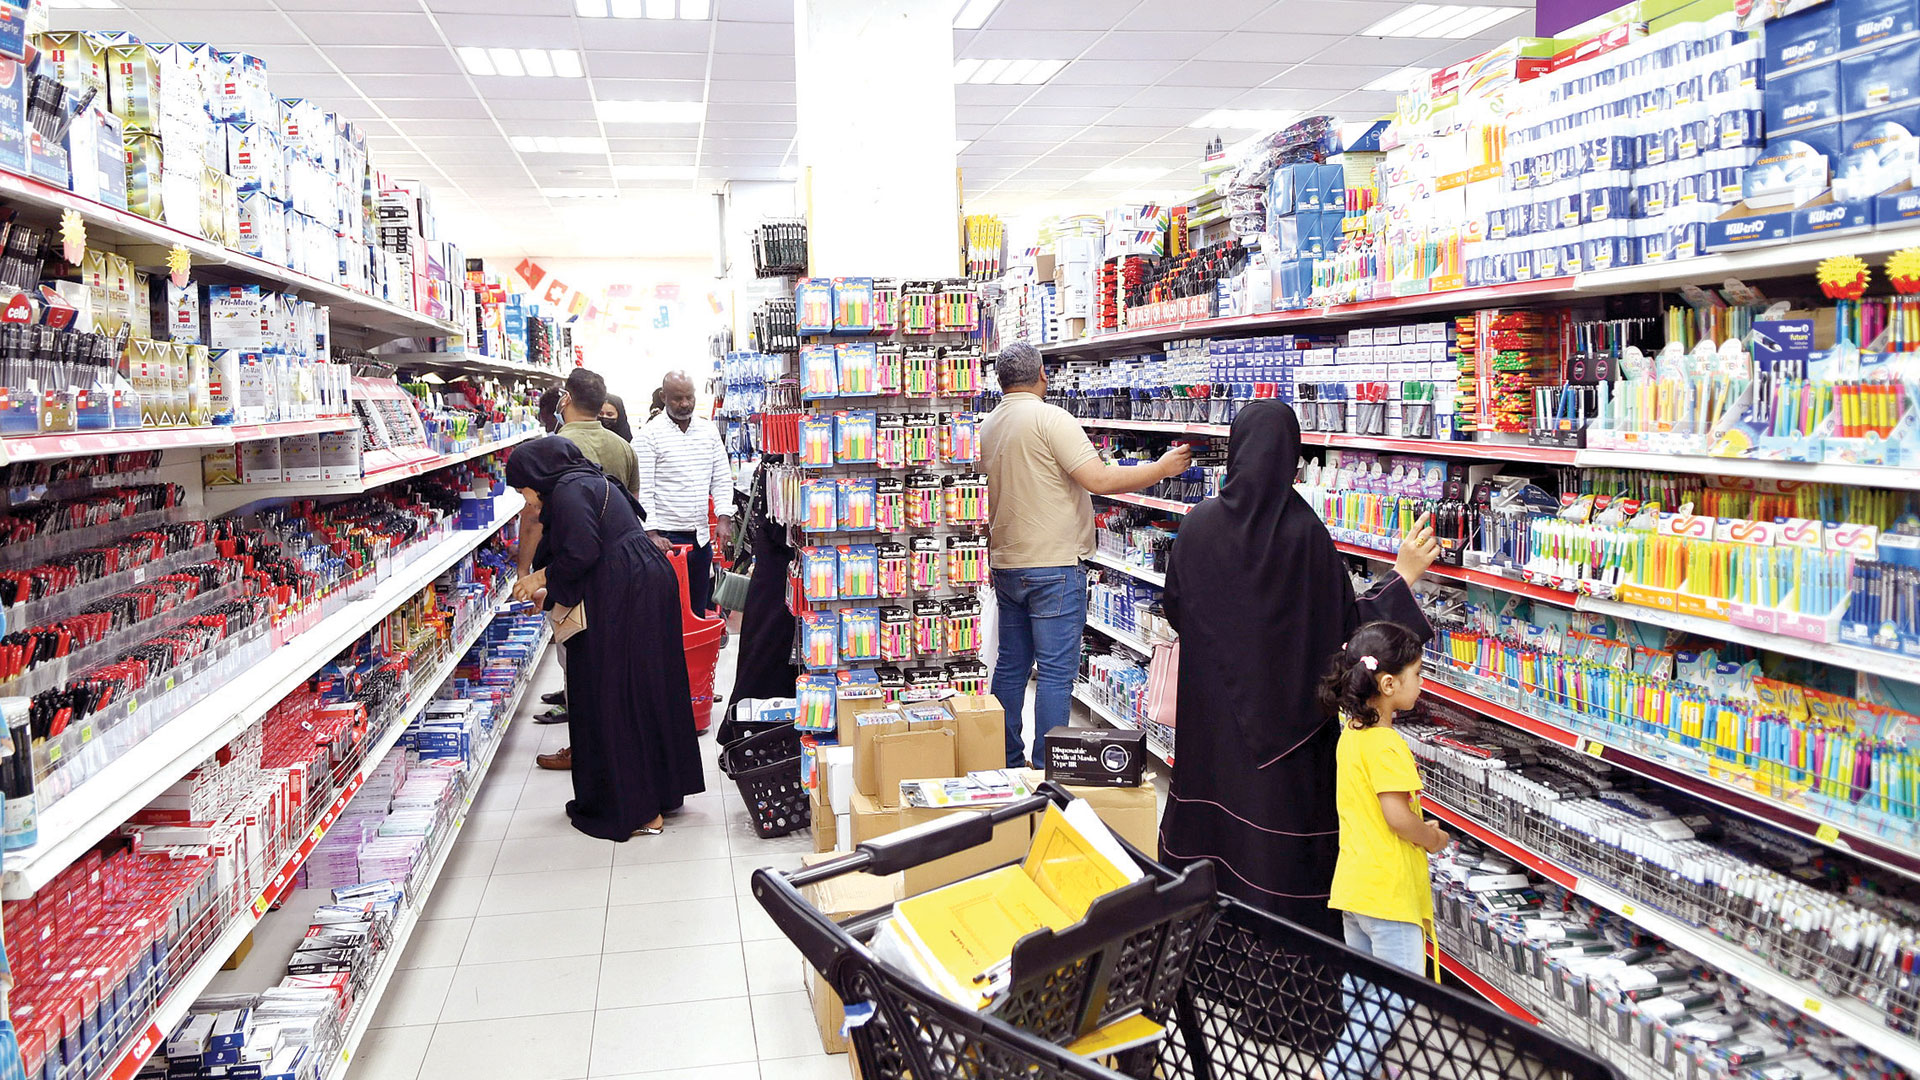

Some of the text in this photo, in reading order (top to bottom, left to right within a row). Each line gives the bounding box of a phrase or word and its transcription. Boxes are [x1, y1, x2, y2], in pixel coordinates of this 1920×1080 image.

[1856, 16, 1894, 38] KW-triO
[1782, 40, 1817, 60] KW-triO
[1783, 101, 1818, 119] KW-triO
[1853, 137, 1888, 149] CORRECTION
[1757, 155, 1793, 165] CORRECTION
[1808, 207, 1846, 224] KW-triO
[1725, 220, 1765, 236] KW-triO
[8, 305, 29, 321] cello
[276, 611, 298, 631] cello
[1052, 746, 1087, 754] Disposable
